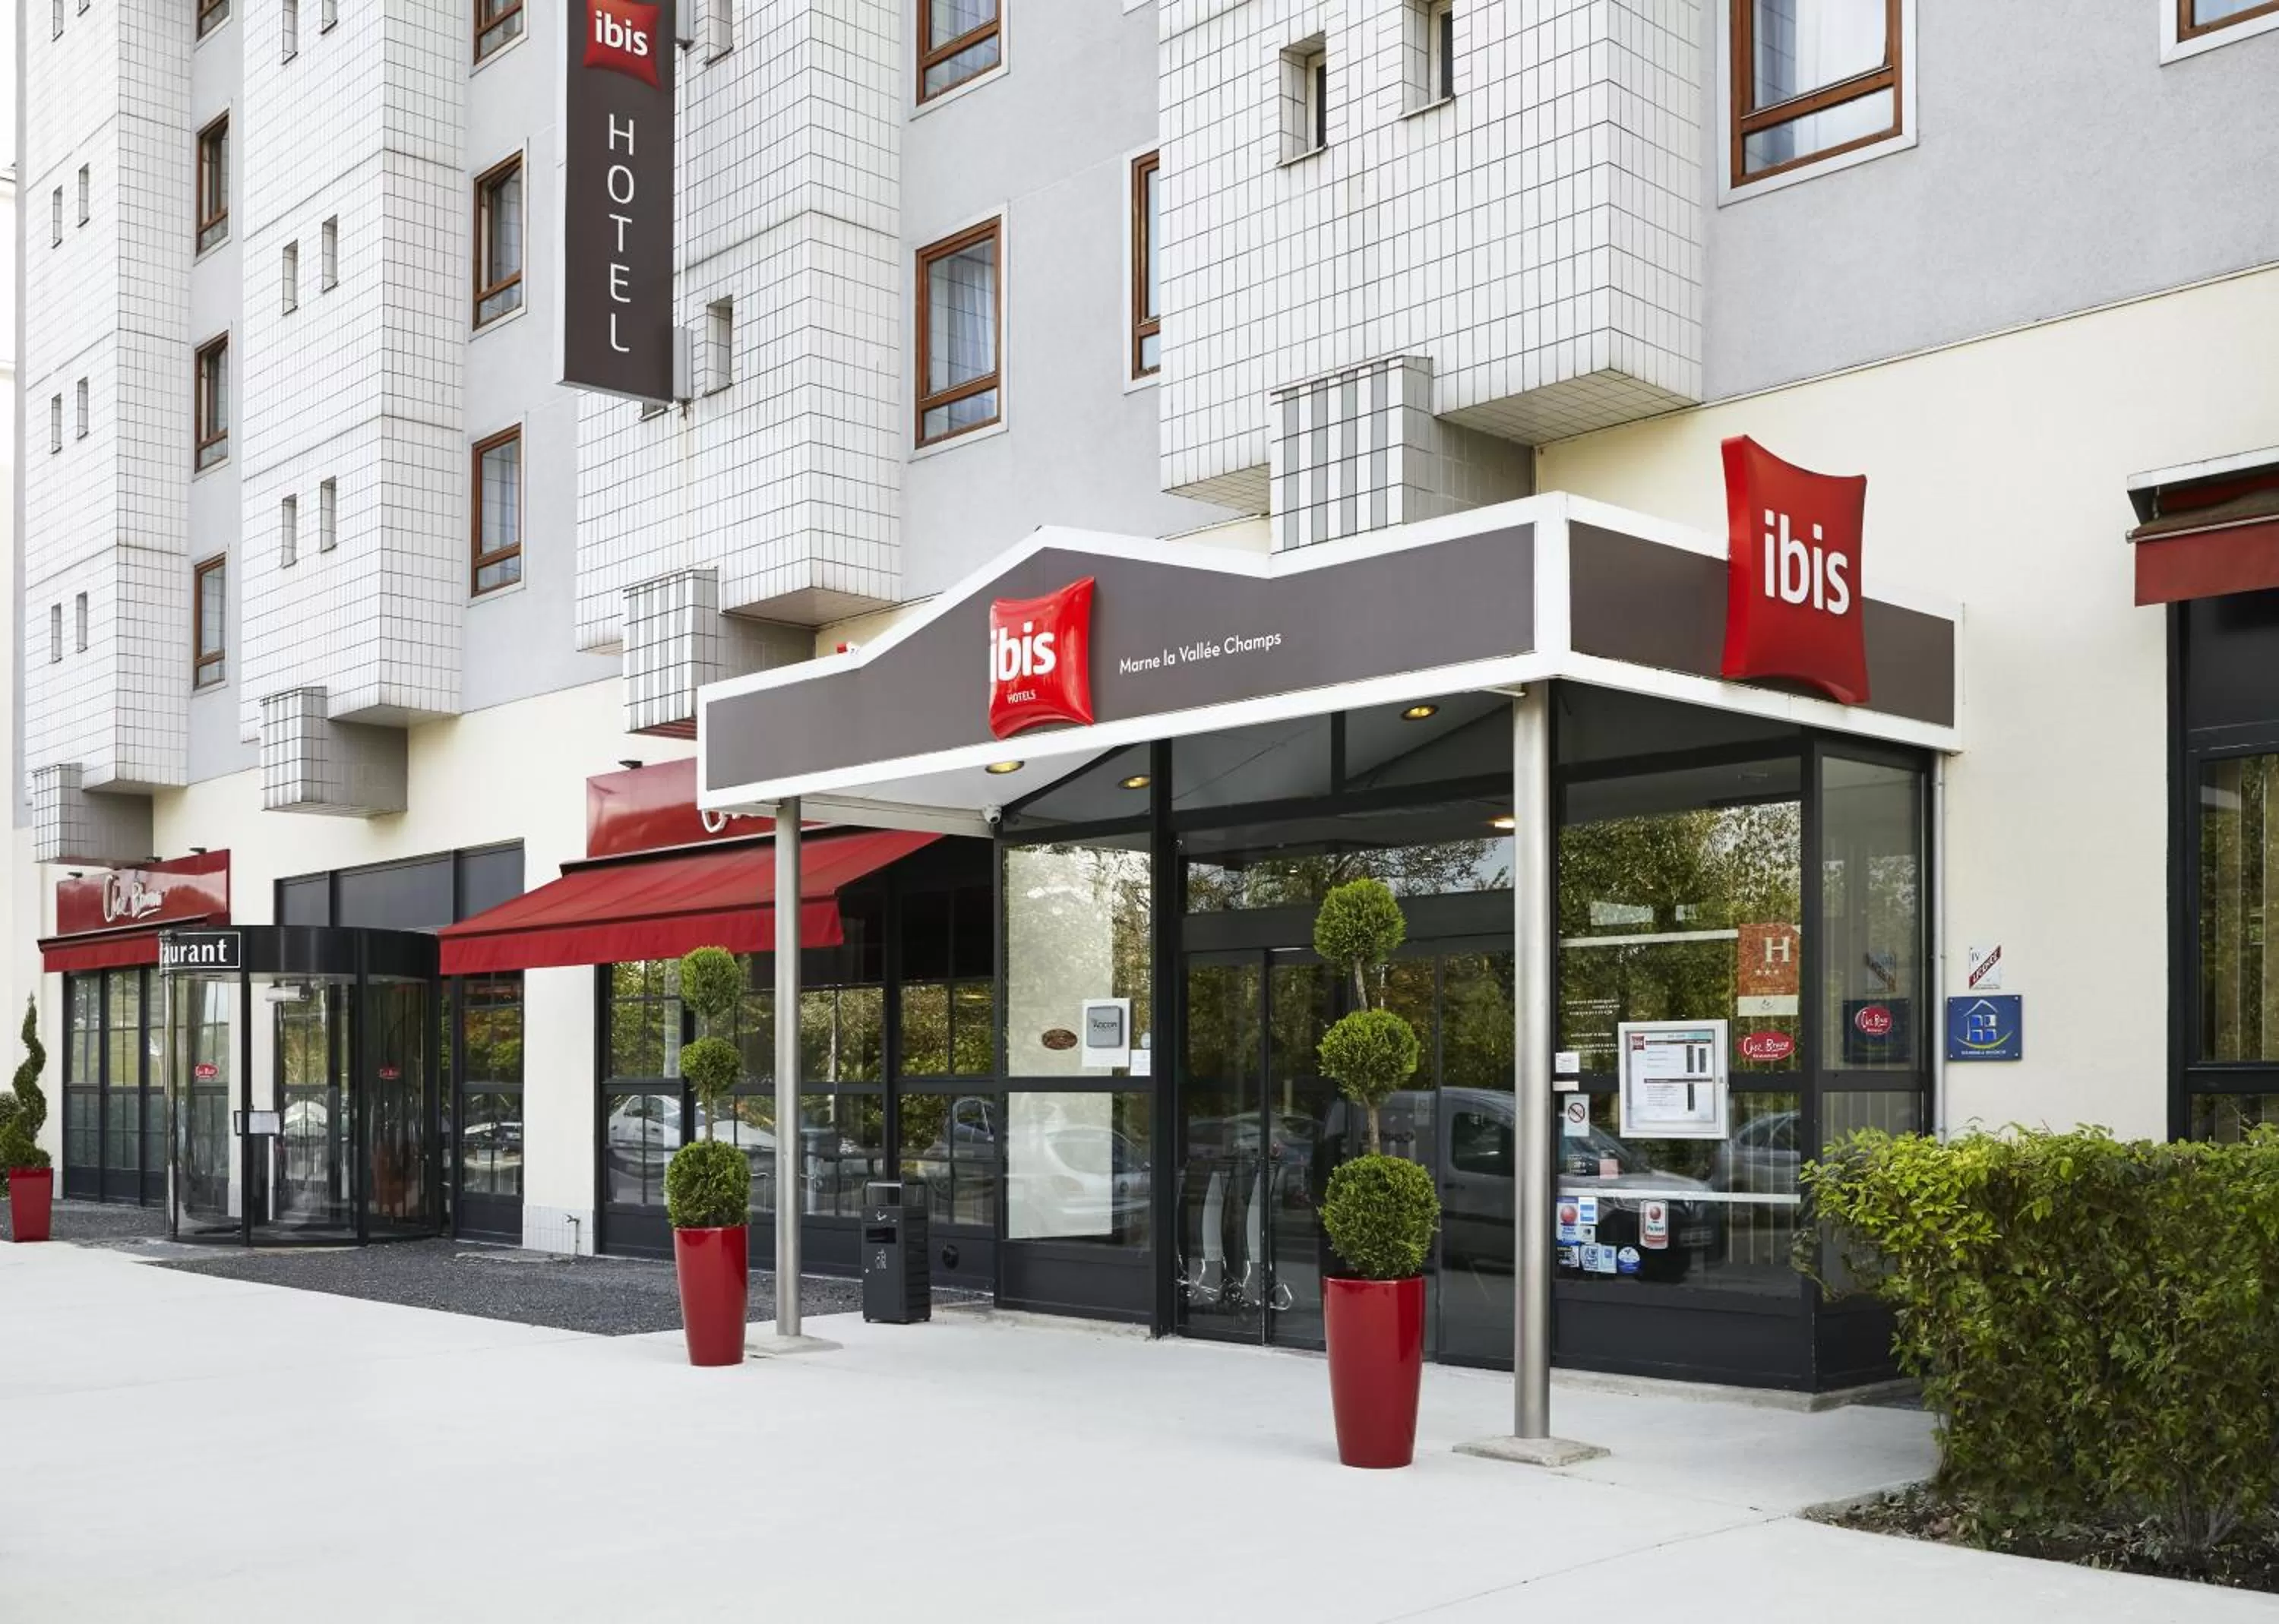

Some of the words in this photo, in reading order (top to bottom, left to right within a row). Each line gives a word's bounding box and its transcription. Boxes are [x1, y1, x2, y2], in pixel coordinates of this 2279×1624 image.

[595, 10, 648, 57] ibis
[607, 113, 635, 353] HOTEL
[1764, 508, 1851, 615] ibis
[990, 621, 1057, 682] ibis
[1119, 657, 1161, 675] Marne
[1163, 649, 1176, 666] la
[1178, 640, 1221, 662] Vallée
[1224, 633, 1282, 655] Champs
[1006, 688, 1037, 704] HOTELS
[1764, 936, 1791, 963] H
